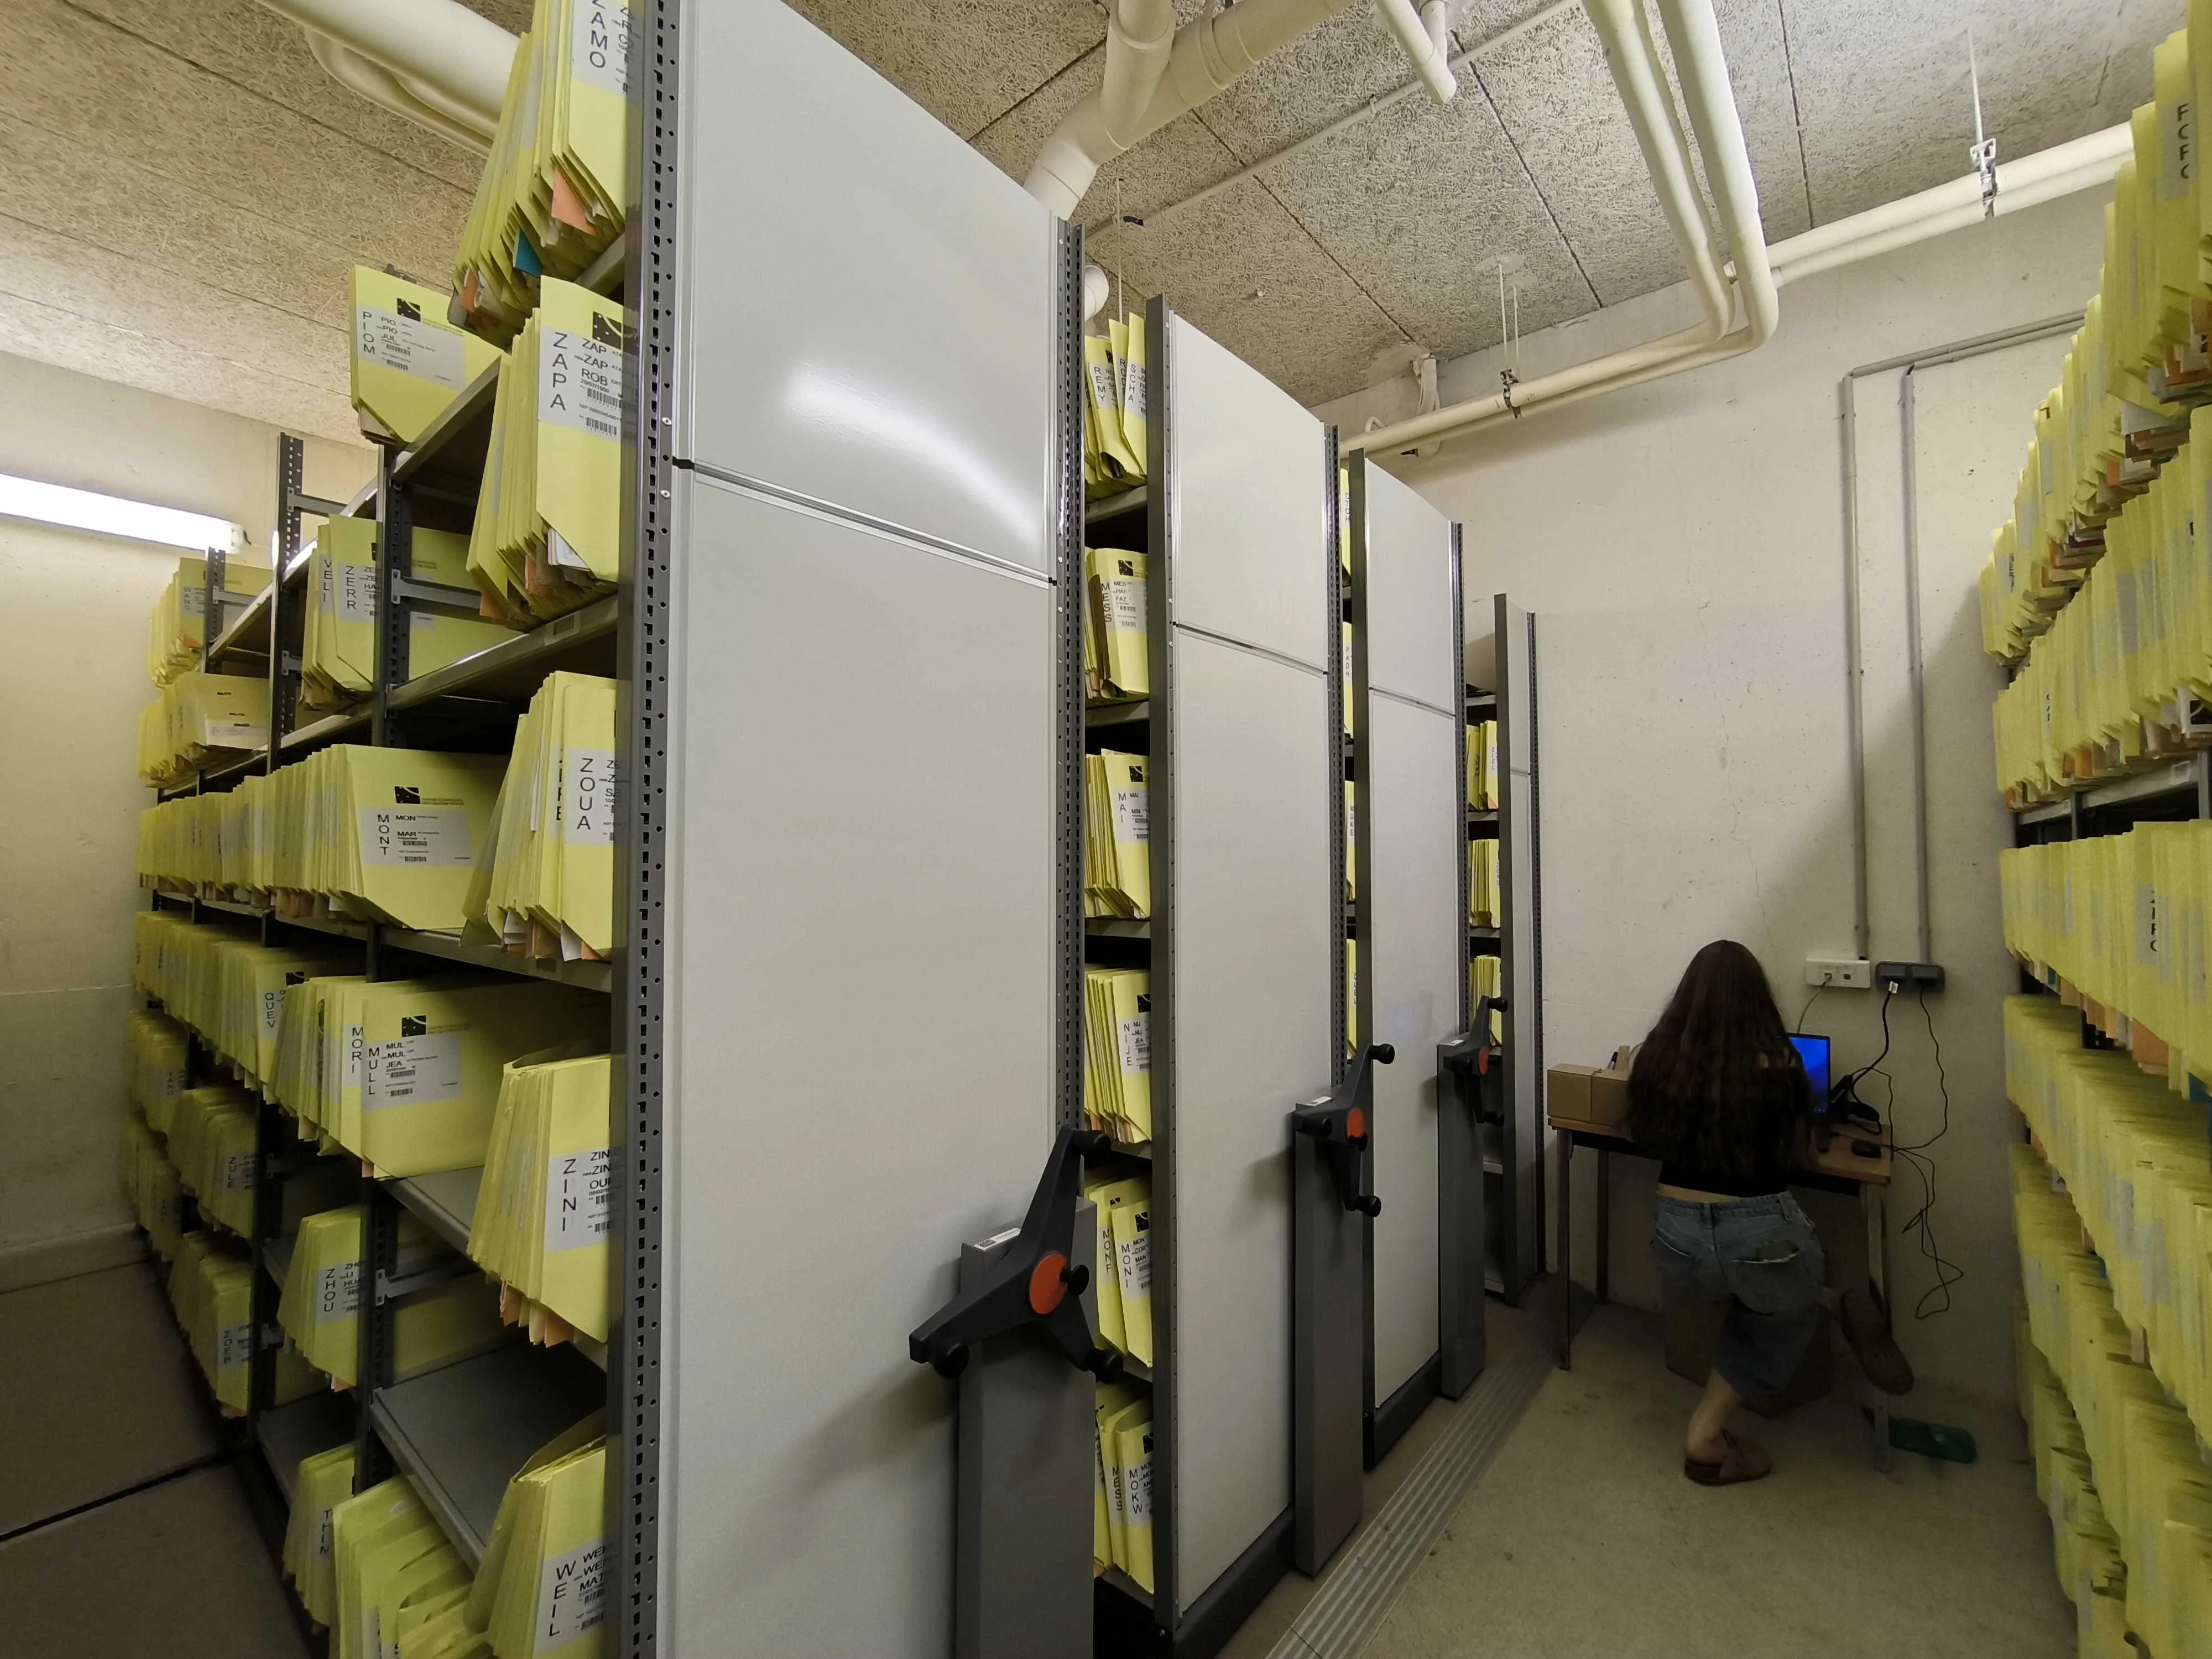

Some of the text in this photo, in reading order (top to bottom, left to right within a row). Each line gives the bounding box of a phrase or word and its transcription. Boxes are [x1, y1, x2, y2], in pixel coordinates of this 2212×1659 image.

[363, 311, 375, 354] PIOM
[381, 316, 396, 325] PIO
[381, 333, 397, 342] JUL
[383, 325, 398, 334] PIO
[582, 338, 607, 353] ZAP
[584, 354, 608, 369] ZAP
[550, 332, 568, 410] ZAPA
[581, 368, 608, 386] ROB
[1094, 367, 1106, 401] REMY
[323, 559, 332, 602] VELI
[346, 566, 357, 611] ZERR
[1101, 582, 1112, 623] MESS
[577, 758, 596, 830] ZOUA
[1118, 792, 1126, 823] MAI
[377, 814, 390, 855] MONT
[352, 1026, 363, 1074] MORI
[1124, 1022, 1133, 1066] NIJE
[368, 1047, 379, 1095] MULL
[562, 1157, 576, 1232] ZINI
[1121, 1243, 1132, 1288] MONI
[324, 1267, 336, 1312] ZHOU
[1129, 1468, 1142, 1515] MOKW
[549, 1559, 577, 1637] WEIL
